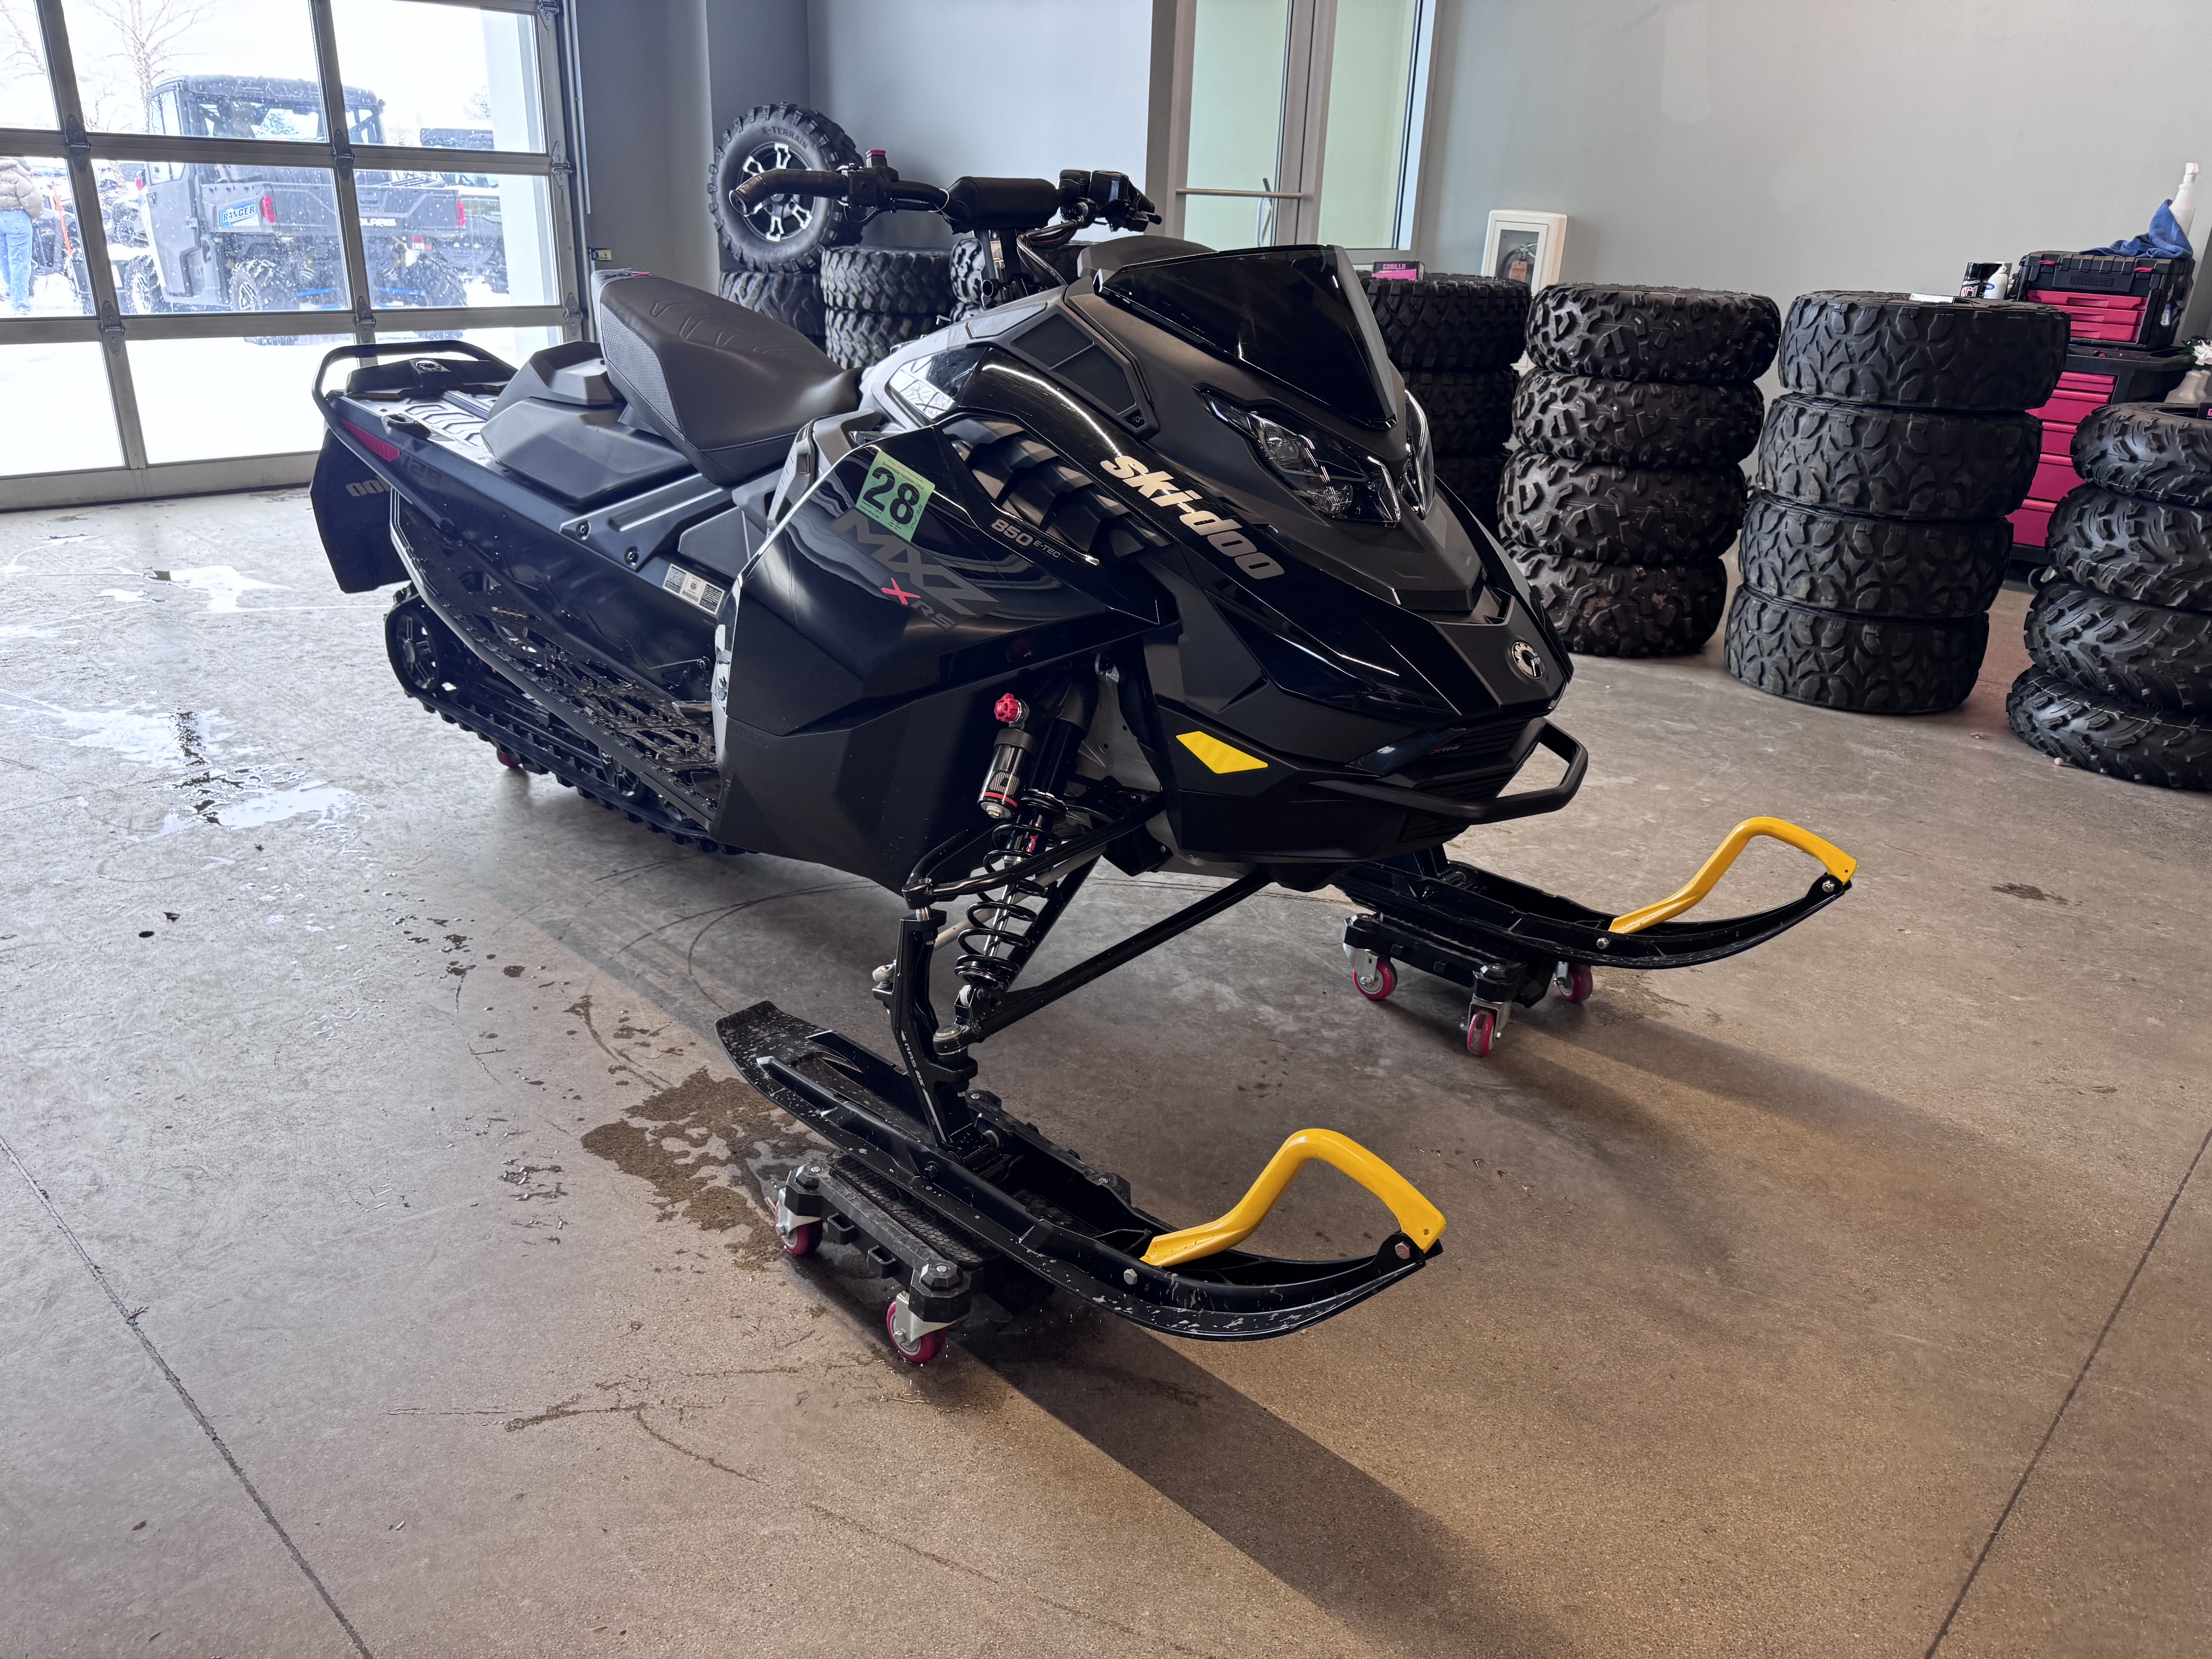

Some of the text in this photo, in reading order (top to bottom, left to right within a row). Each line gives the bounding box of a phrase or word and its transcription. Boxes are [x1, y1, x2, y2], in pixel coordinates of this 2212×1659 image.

[761, 126, 809, 149] X-TERRAIN
[223, 206, 255, 222] RANGER
[863, 467, 920, 525] 28
[991, 519, 1061, 558] 850 E-TEC
[831, 508, 1001, 616] MXZ
[904, 1043, 917, 1068] RAS
